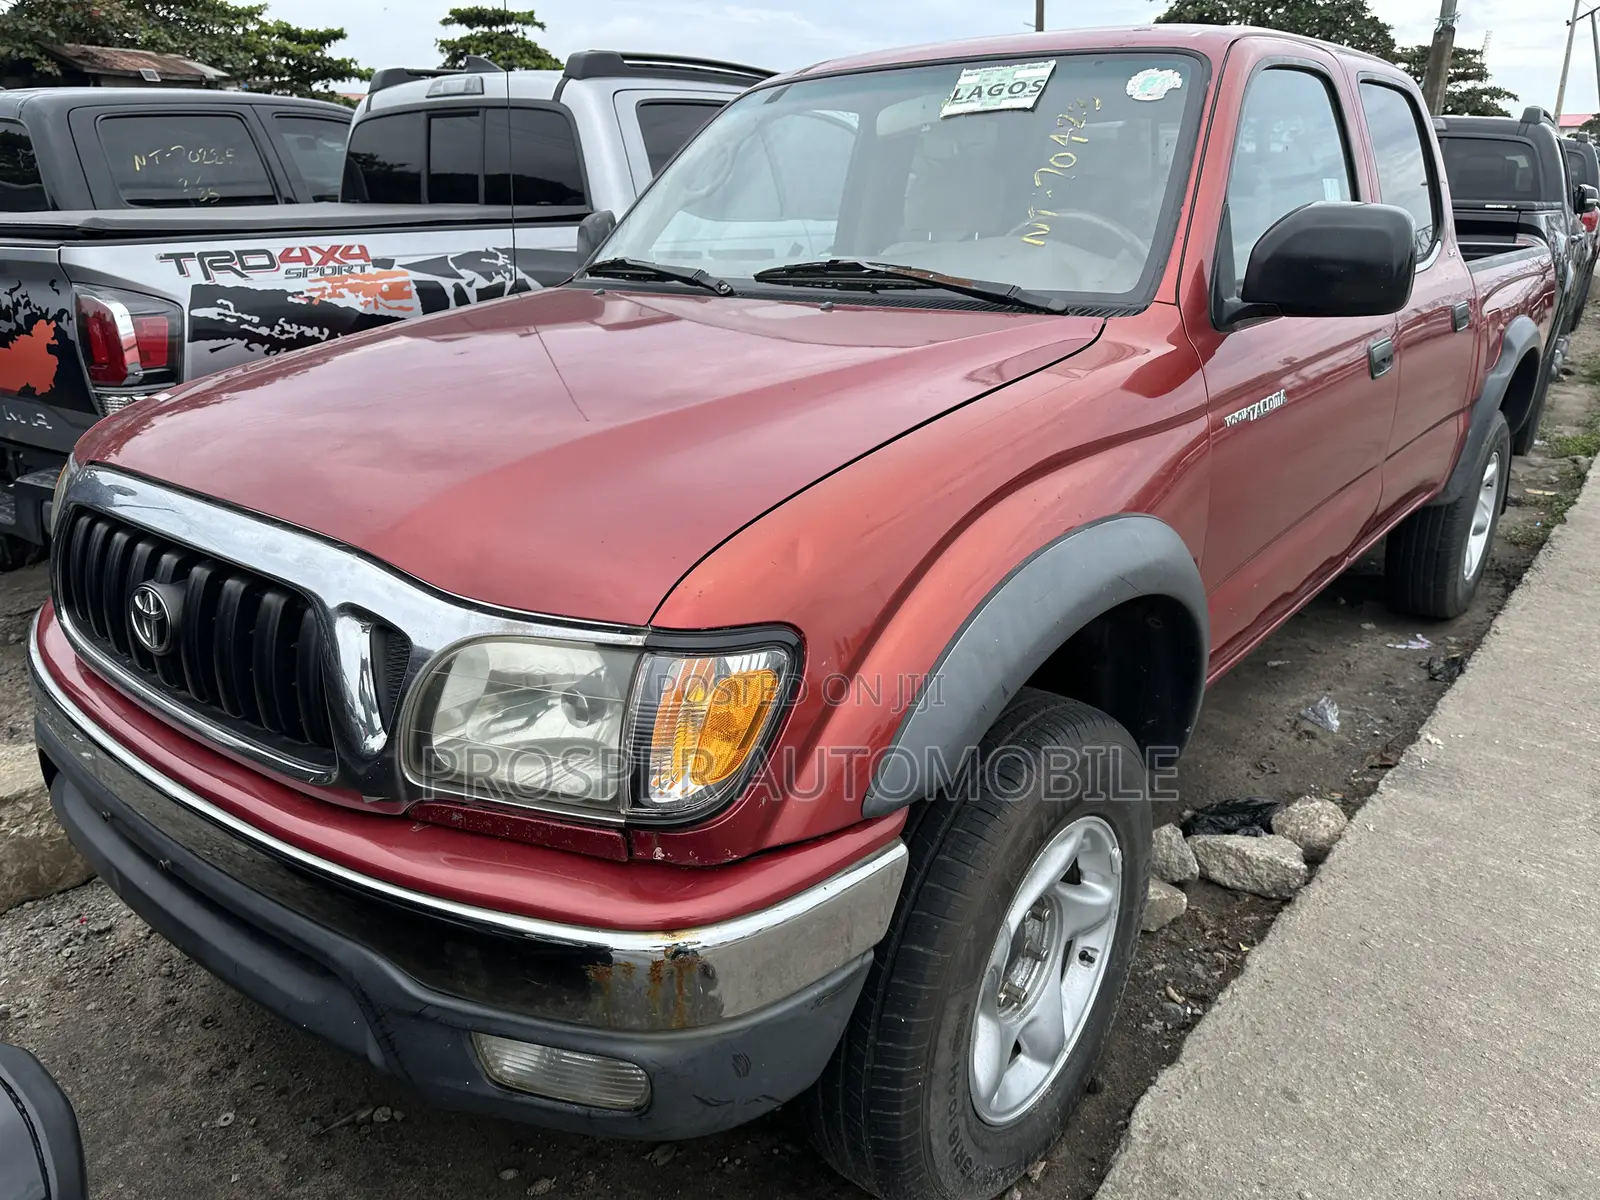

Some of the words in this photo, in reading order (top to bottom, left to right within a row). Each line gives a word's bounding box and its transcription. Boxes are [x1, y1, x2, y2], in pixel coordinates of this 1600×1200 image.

[950, 79, 1047, 102] LAGOS
[157, 248, 281, 283] TRD
[284, 263, 371, 280] SPORT
